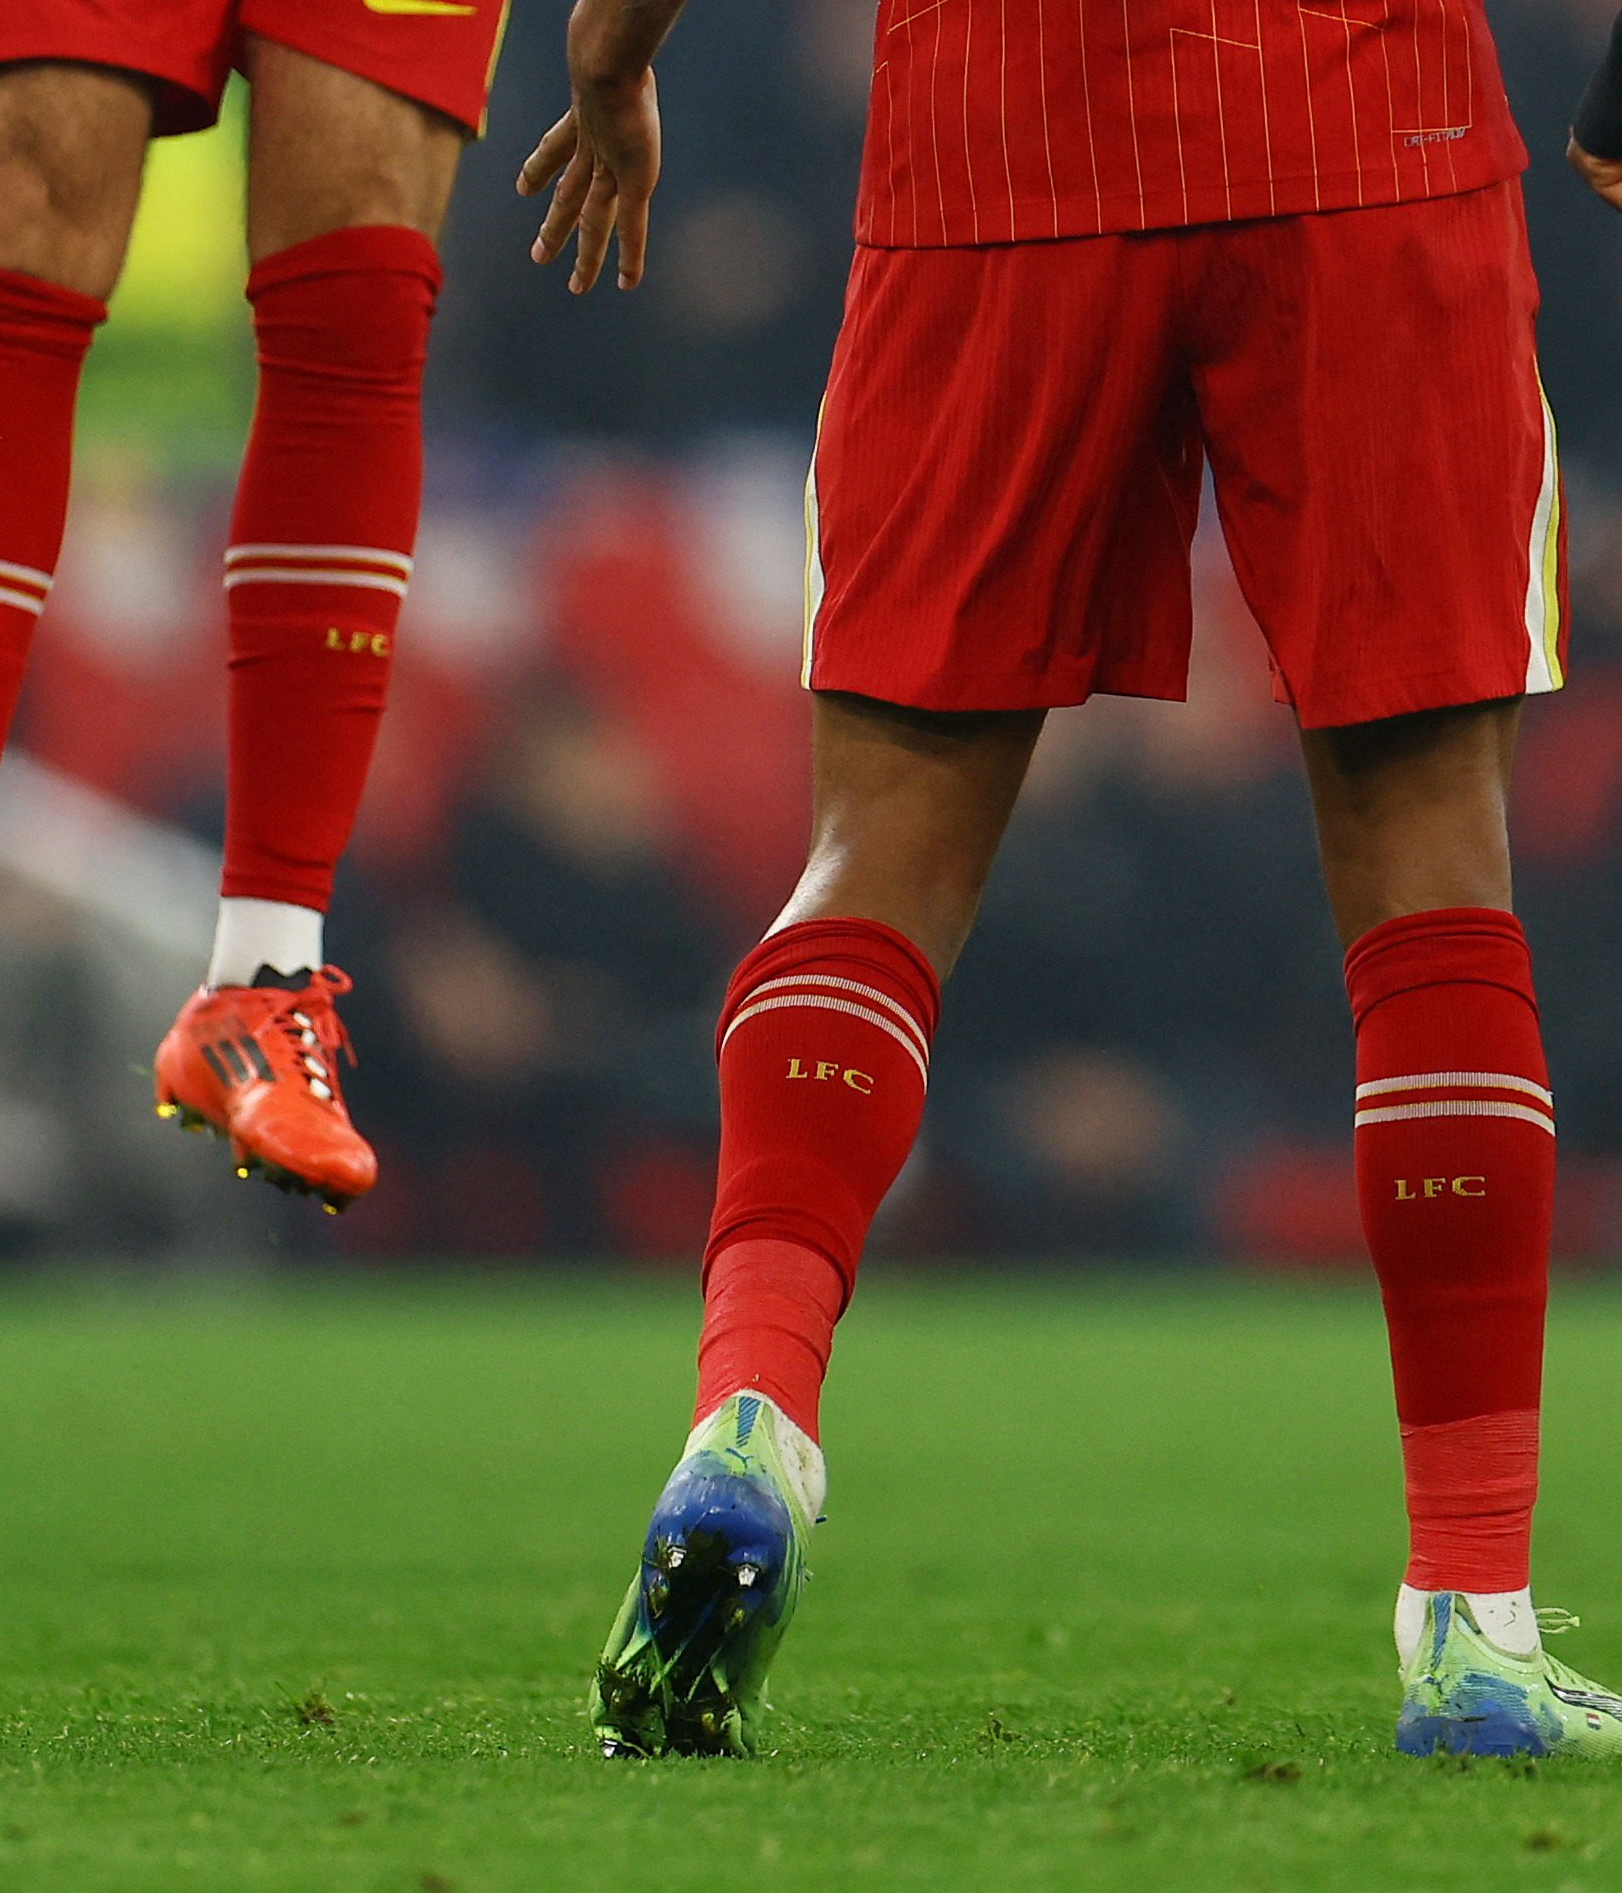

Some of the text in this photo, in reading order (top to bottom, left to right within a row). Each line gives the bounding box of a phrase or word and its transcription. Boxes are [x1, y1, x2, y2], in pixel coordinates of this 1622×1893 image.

[325, 627, 391, 657] LFC
[785, 1058, 874, 1095] LFC
[1394, 1176, 1487, 1200] LFC
